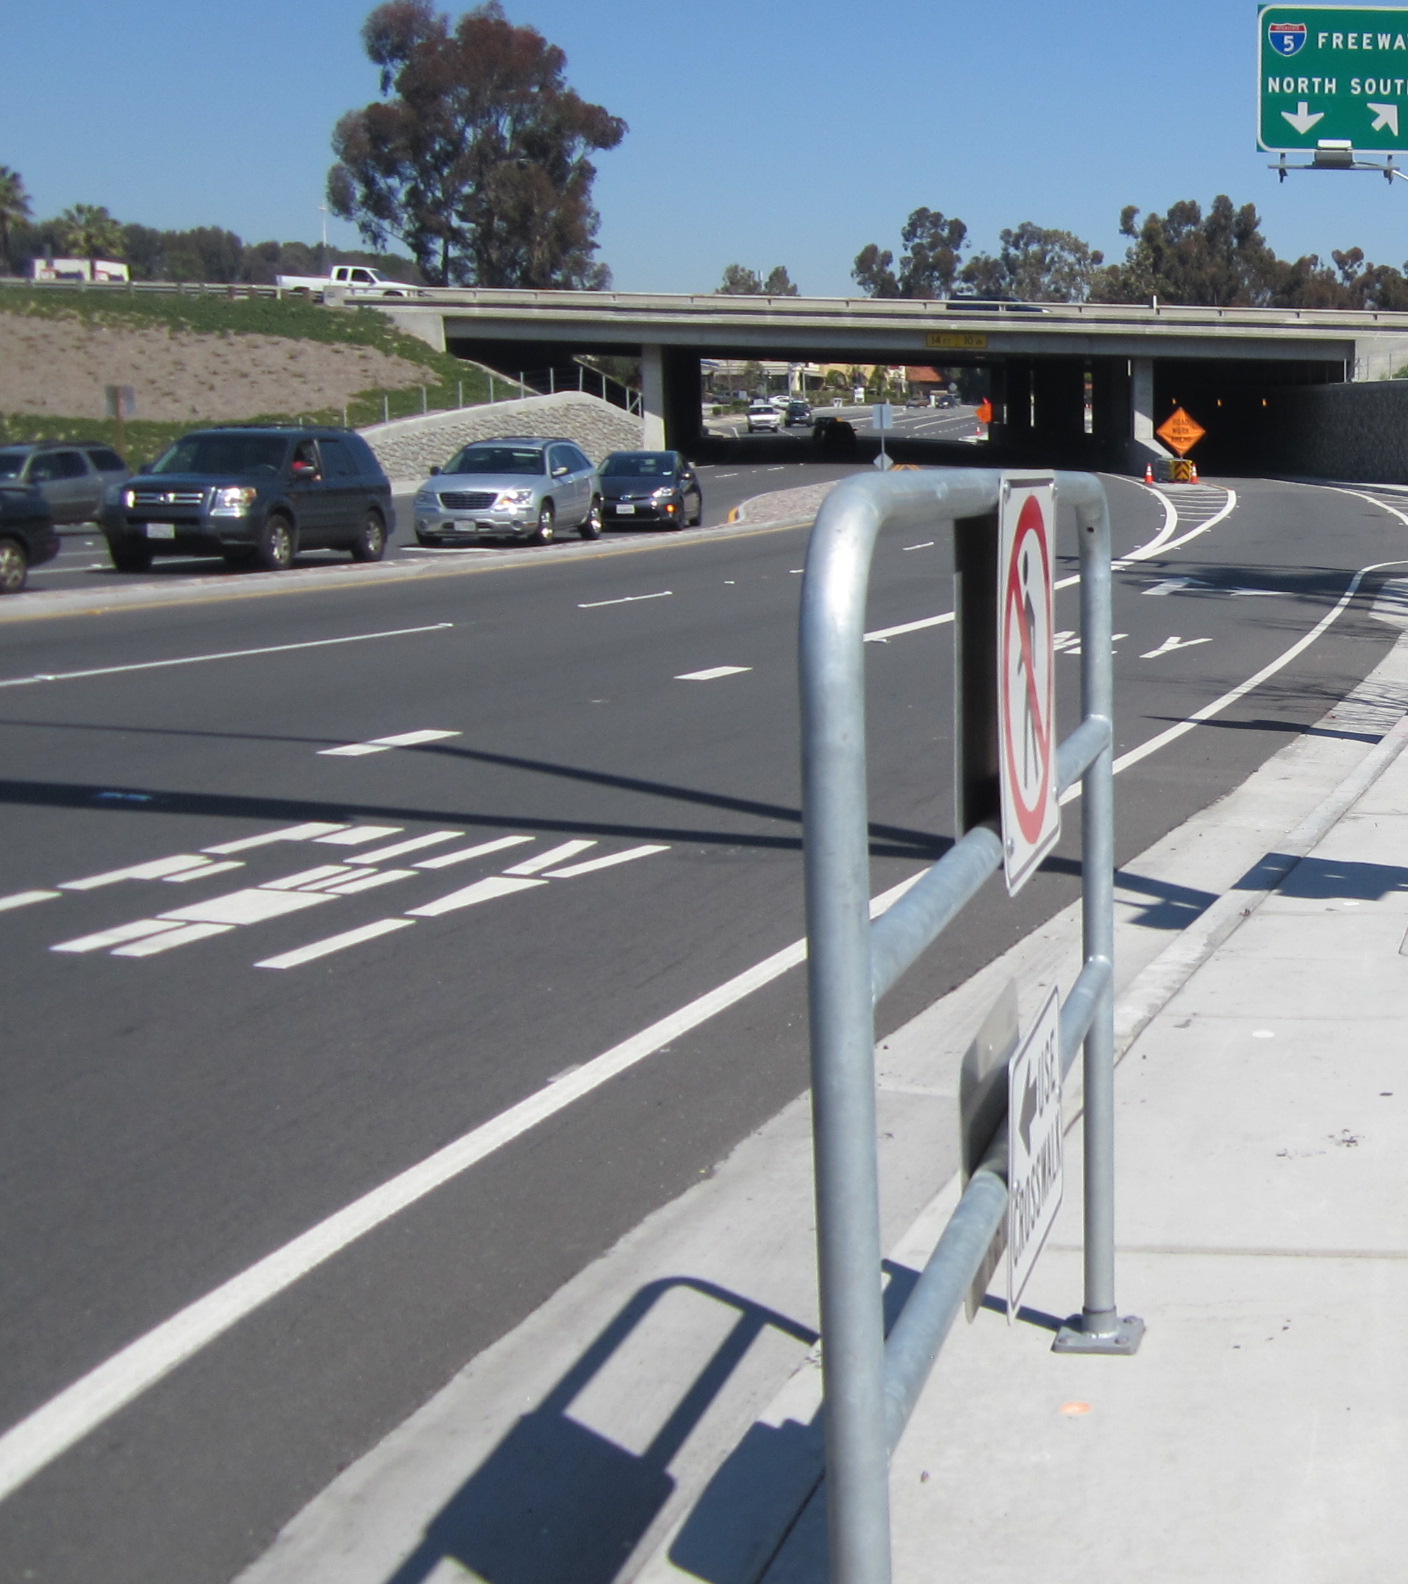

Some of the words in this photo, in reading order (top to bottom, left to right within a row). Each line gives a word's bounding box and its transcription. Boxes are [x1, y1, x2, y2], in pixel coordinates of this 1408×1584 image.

[1283, 35, 1295, 52] 5
[1268, 76, 1337, 94] NORTH
[1037, 1027, 1055, 1119] USE
[1013, 1109, 1062, 1268] CROSSWALK
